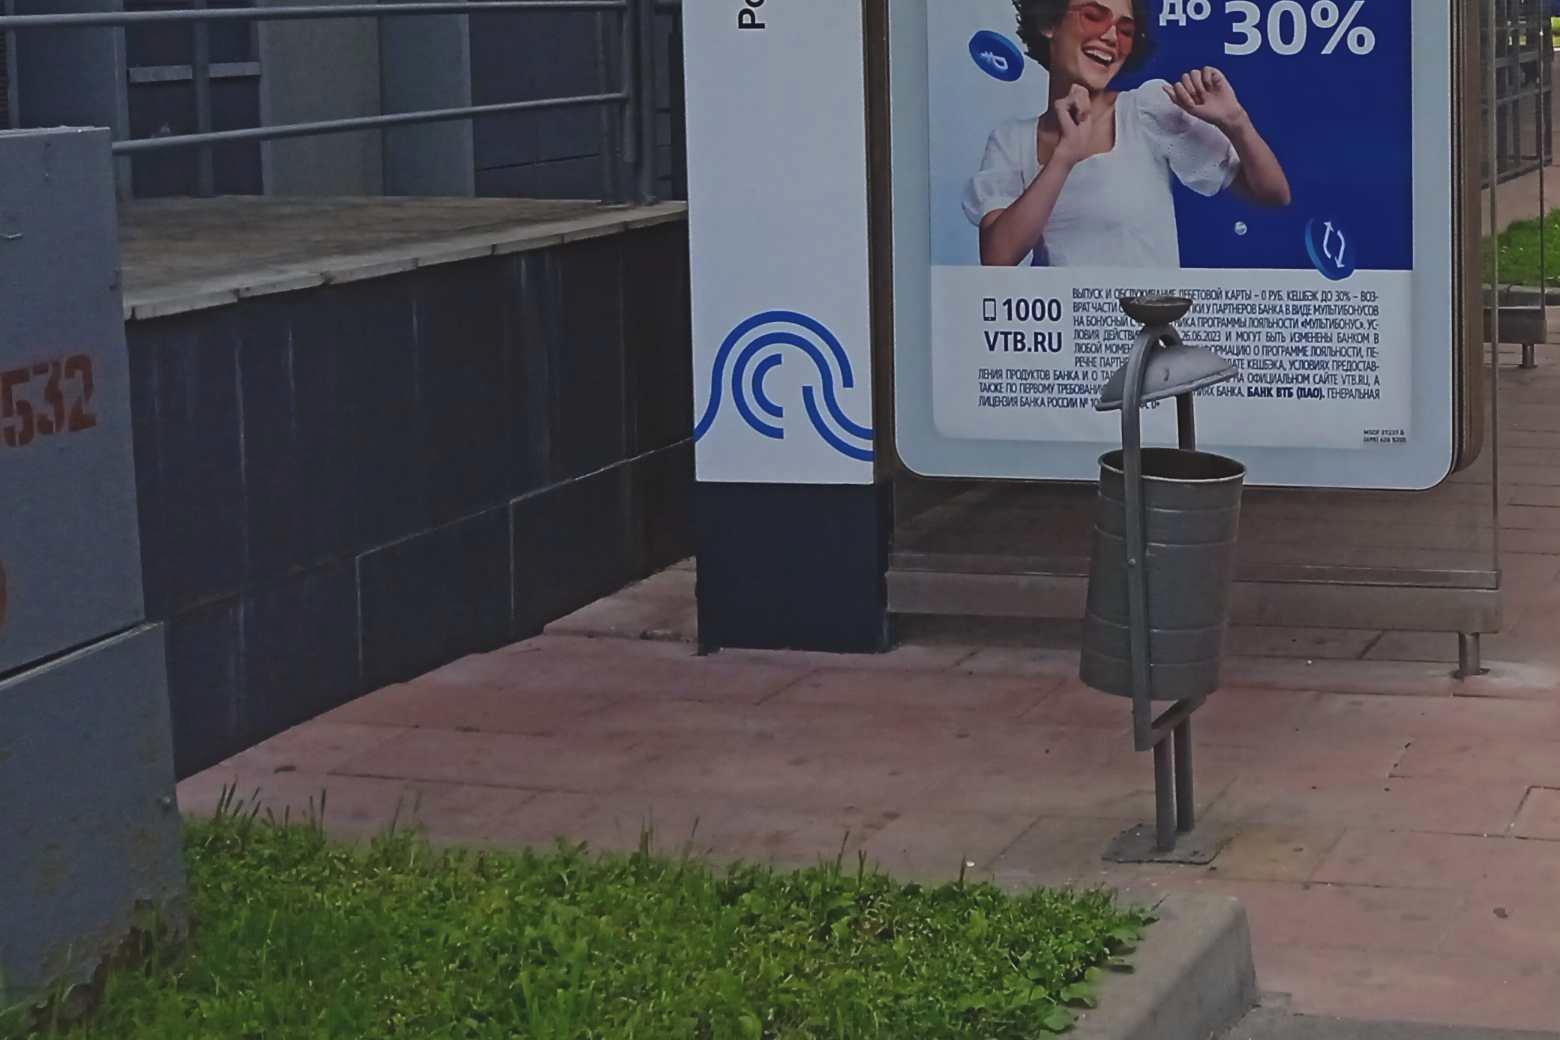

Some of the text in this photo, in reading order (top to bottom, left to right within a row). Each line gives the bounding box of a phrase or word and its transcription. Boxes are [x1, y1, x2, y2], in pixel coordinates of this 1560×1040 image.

[1223, 0, 1376, 56] 30%
[1072, 288, 1103, 300] ВЫПУСК
[1105, 288, 1112, 299] И
[1225, 289, 1252, 301] КАРТЫ
[1286, 290, 1319, 303] КЕШБЭК
[1320, 290, 1333, 303] ДО
[1002, 297, 1062, 322] 1000
[1072, 301, 1090, 312] ВРАТ
[1091, 301, 1117, 313] ЧАСТИ
[1212, 303, 1257, 315] ПАРТНЕРОВ
[1258, 304, 1284, 315] БАНКА
[1285, 304, 1291, 315] В
[1291, 304, 1312, 317] ВИДЕ
[1313, 304, 1380, 316] МУЛЬТИБОНУСОВ
[1073, 315, 1086, 326] НА
[1086, 314, 1128, 327] БОНУСНЫЙ
[1197, 317, 1246, 328] ПРОГРАММЫ
[1248, 317, 1299, 329] ЛОЯЛЬНОСТИ
[983, 330, 1063, 353] VTB.RU
[1074, 329, 1100, 340] ЛОВИЯ
[1225, 331, 1232, 341] И
[1236, 331, 1262, 342] МОГУТ
[1265, 331, 1286, 343] БЫТЬ
[1290, 331, 1333, 343] ИЗМЕНЕНЫ
[1337, 332, 1370, 344] БАНКОМ
[1374, 333, 1380, 344] В
[1075, 342, 1102, 354] ЛЮБОЙ
[1253, 345, 1260, 356] О
[1262, 345, 1308, 357] ПРОГРАММЕ
[1288, 359, 1329, 371] УСЛОВИЯХ
[1332, 359, 1379, 372] ПРЕДОСТАВ-
[978, 368, 1002, 380] ЛЕНИЯ
[1006, 369, 1051, 382] ПРОДУКТОВ
[1053, 370, 1080, 381] БАНКА
[1082, 370, 1089, 381] И
[1091, 370, 1098, 381] О
[1247, 372, 1310, 385] ОФИЦИАЛЬНОМ
[1312, 371, 1338, 385] САЙТЕ
[1373, 374, 1380, 386] А
[979, 382, 1004, 393] ТАКЖЕ
[1005, 383, 1017, 394] ПО
[1019, 383, 1054, 394] ПЕРВОМУ
[1057, 383, 1102, 396] ТРЕБОВАНИ
[1247, 386, 1273, 398] БАНК
[1276, 386, 1294, 398] ВТБ
[1296, 386, 1325, 400] (ПАО).
[1327, 387, 1381, 400] ГЕНЕРАЛЬНАЯ
[0, 353, 97, 449] 532
[978, 396, 1018, 409] ЛИЦЕНЗИЯ
[1019, 397, 1046, 408] БАНКА
[1047, 397, 1078, 409] РОССИИ
